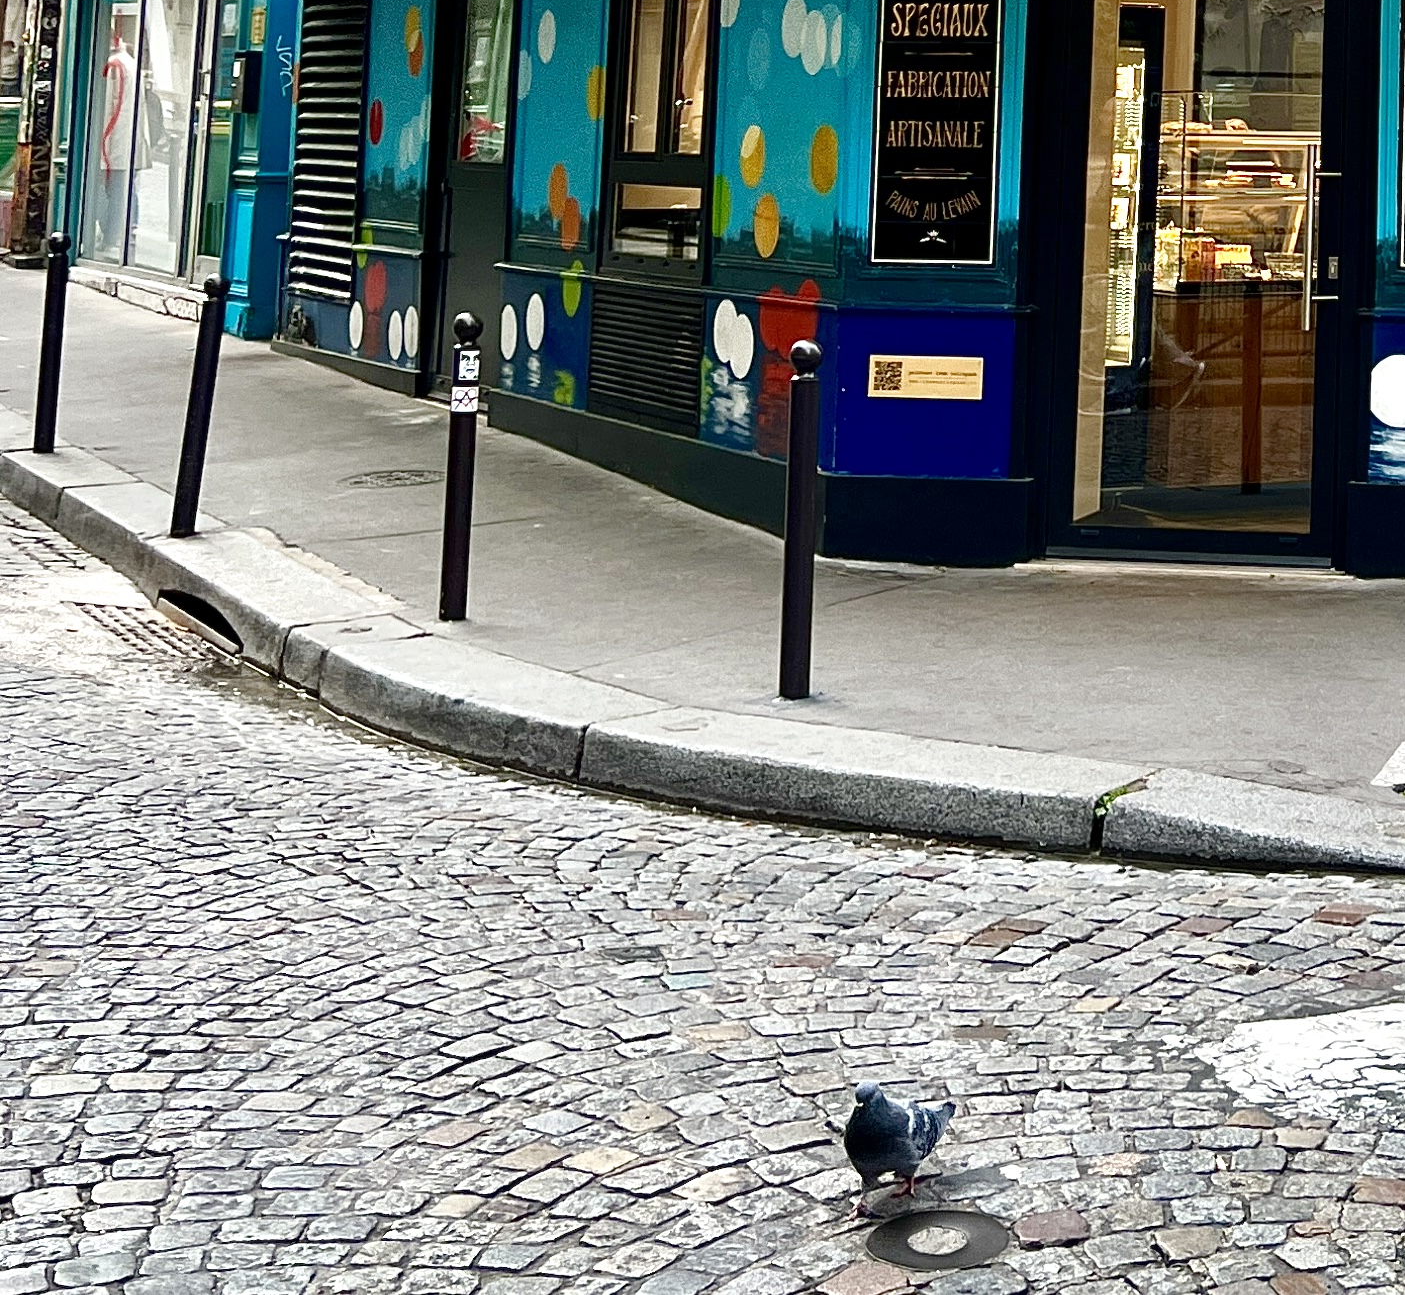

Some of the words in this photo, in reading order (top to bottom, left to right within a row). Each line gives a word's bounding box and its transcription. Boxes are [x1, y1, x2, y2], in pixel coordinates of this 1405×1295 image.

[886, 70, 991, 98] FABRICATION
[886, 120, 985, 148] ARTISANALE
[885, 190, 920, 218] PAINS
[923, 202, 937, 221] AU
[942, 190, 981, 220] LEVAIN
